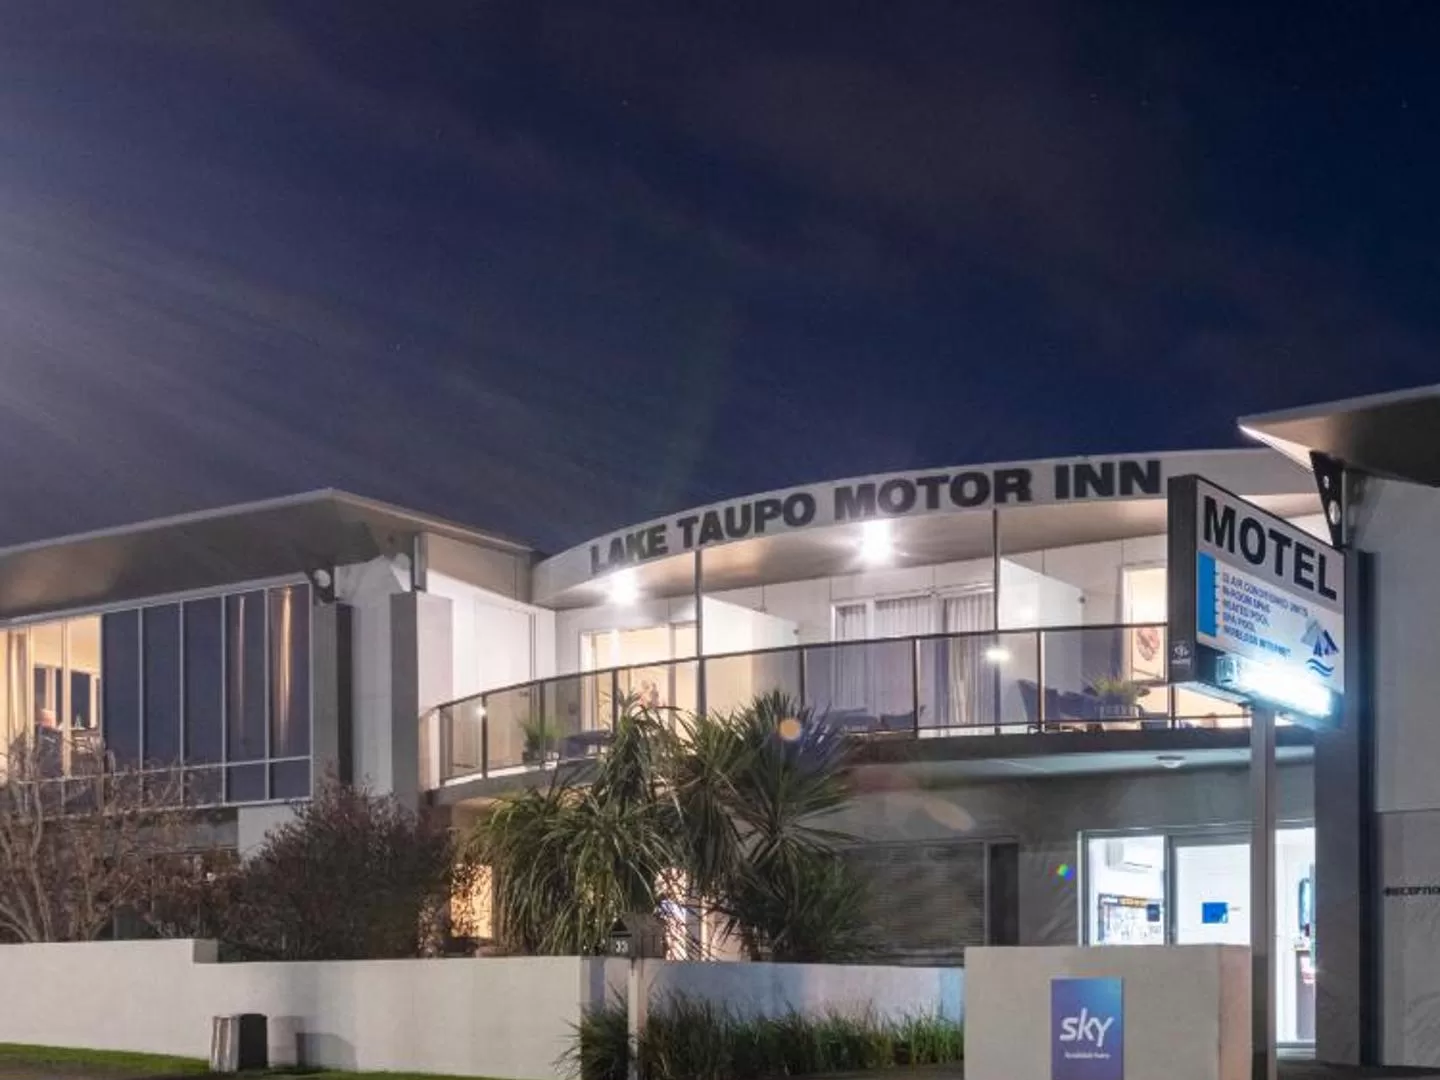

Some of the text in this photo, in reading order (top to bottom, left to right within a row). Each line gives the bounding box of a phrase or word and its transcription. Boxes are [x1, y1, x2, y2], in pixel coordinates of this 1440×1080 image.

[590, 460, 1161, 575] LAKE TAUPO MOTOR INN
[1204, 496, 1337, 600] MOTEL
[1060, 1007, 1115, 1047] sky
